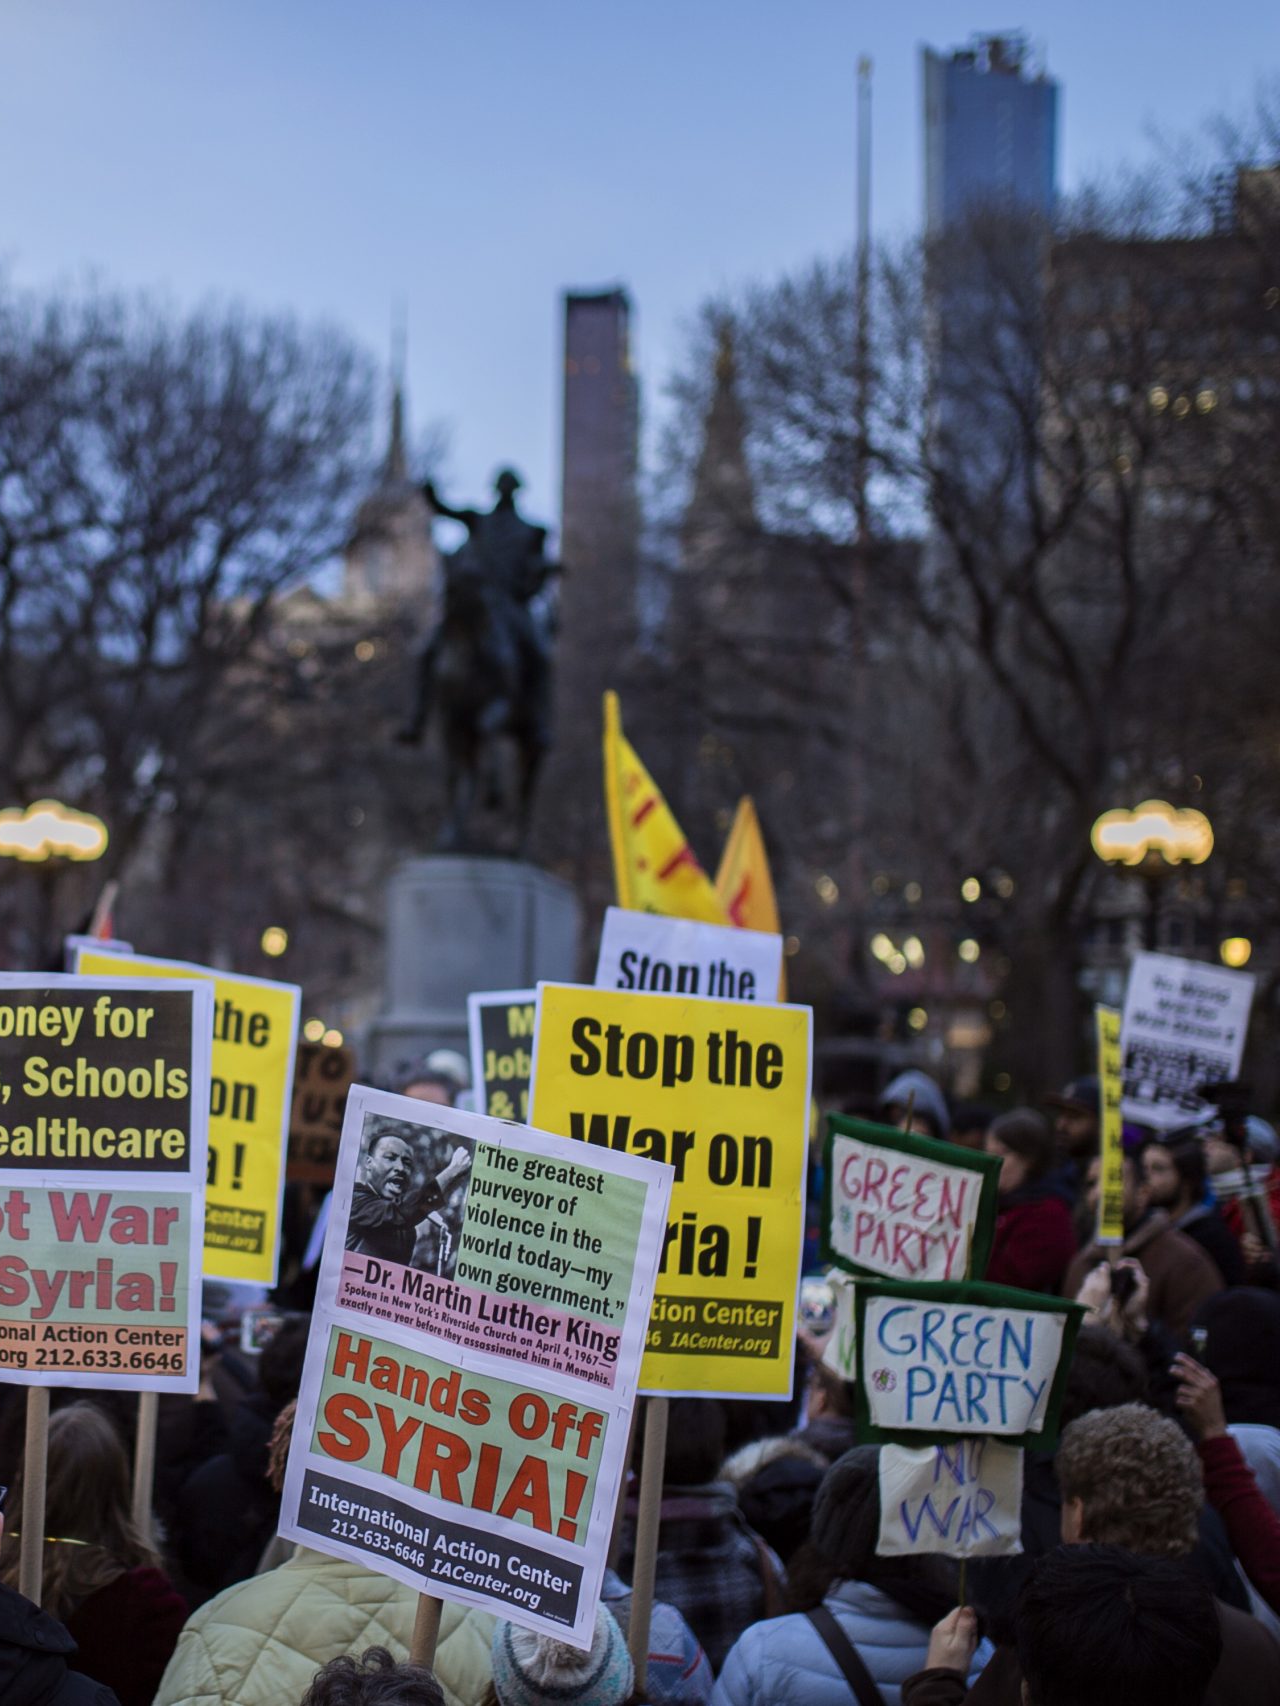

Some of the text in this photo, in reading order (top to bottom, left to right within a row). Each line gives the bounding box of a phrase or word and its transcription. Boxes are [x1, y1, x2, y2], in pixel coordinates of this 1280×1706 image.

[708, 960, 756, 1000] the
[93, 996, 154, 1039] for
[23, 1056, 189, 1099] Schools
[569, 1016, 694, 1088] Stop
[707, 1029, 784, 1090] the
[523, 1158, 604, 1194] greatest
[708, 1132, 773, 1188] on
[48, 1191, 180, 1246] War
[471, 1177, 578, 1216] purveyor of
[840, 1153, 967, 1231] GREEN
[463, 1233, 512, 1260] world
[468, 1204, 602, 1253] violence in the
[854, 1212, 960, 1280] PARTY
[458, 1262, 492, 1285] own
[43, 1324, 108, 1345] Action
[115, 1328, 185, 1347] Center
[344, 1282, 377, 1300] Spoken
[380, 1291, 389, 1303] in
[392, 1295, 412, 1310] New
[441, 1311, 480, 1334] Riverside
[483, 1325, 517, 1343] Church
[520, 1336, 533, 1347] on
[536, 1339, 560, 1355] April
[402, 1269, 472, 1316] Martin
[477, 1294, 561, 1338] Luther
[565, 1317, 620, 1363] King
[650, 1298, 779, 1327] tion Center
[878, 1305, 1034, 1371] GREEN
[34, 1349, 183, 1370] 212.633.6646
[340, 1297, 610, 1386] exactly one year before they assassinated him in Memphis.
[670, 1332, 772, 1355] IACenter.org
[332, 1332, 603, 1460] Hands Off
[907, 1365, 1046, 1425] PARTY
[317, 1392, 589, 1544] SYRIA!
[308, 1485, 573, 1596] International Action Center
[900, 1487, 1000, 1542] WAR
[330, 1518, 542, 1610] 212-633-6646 IACenter.org
